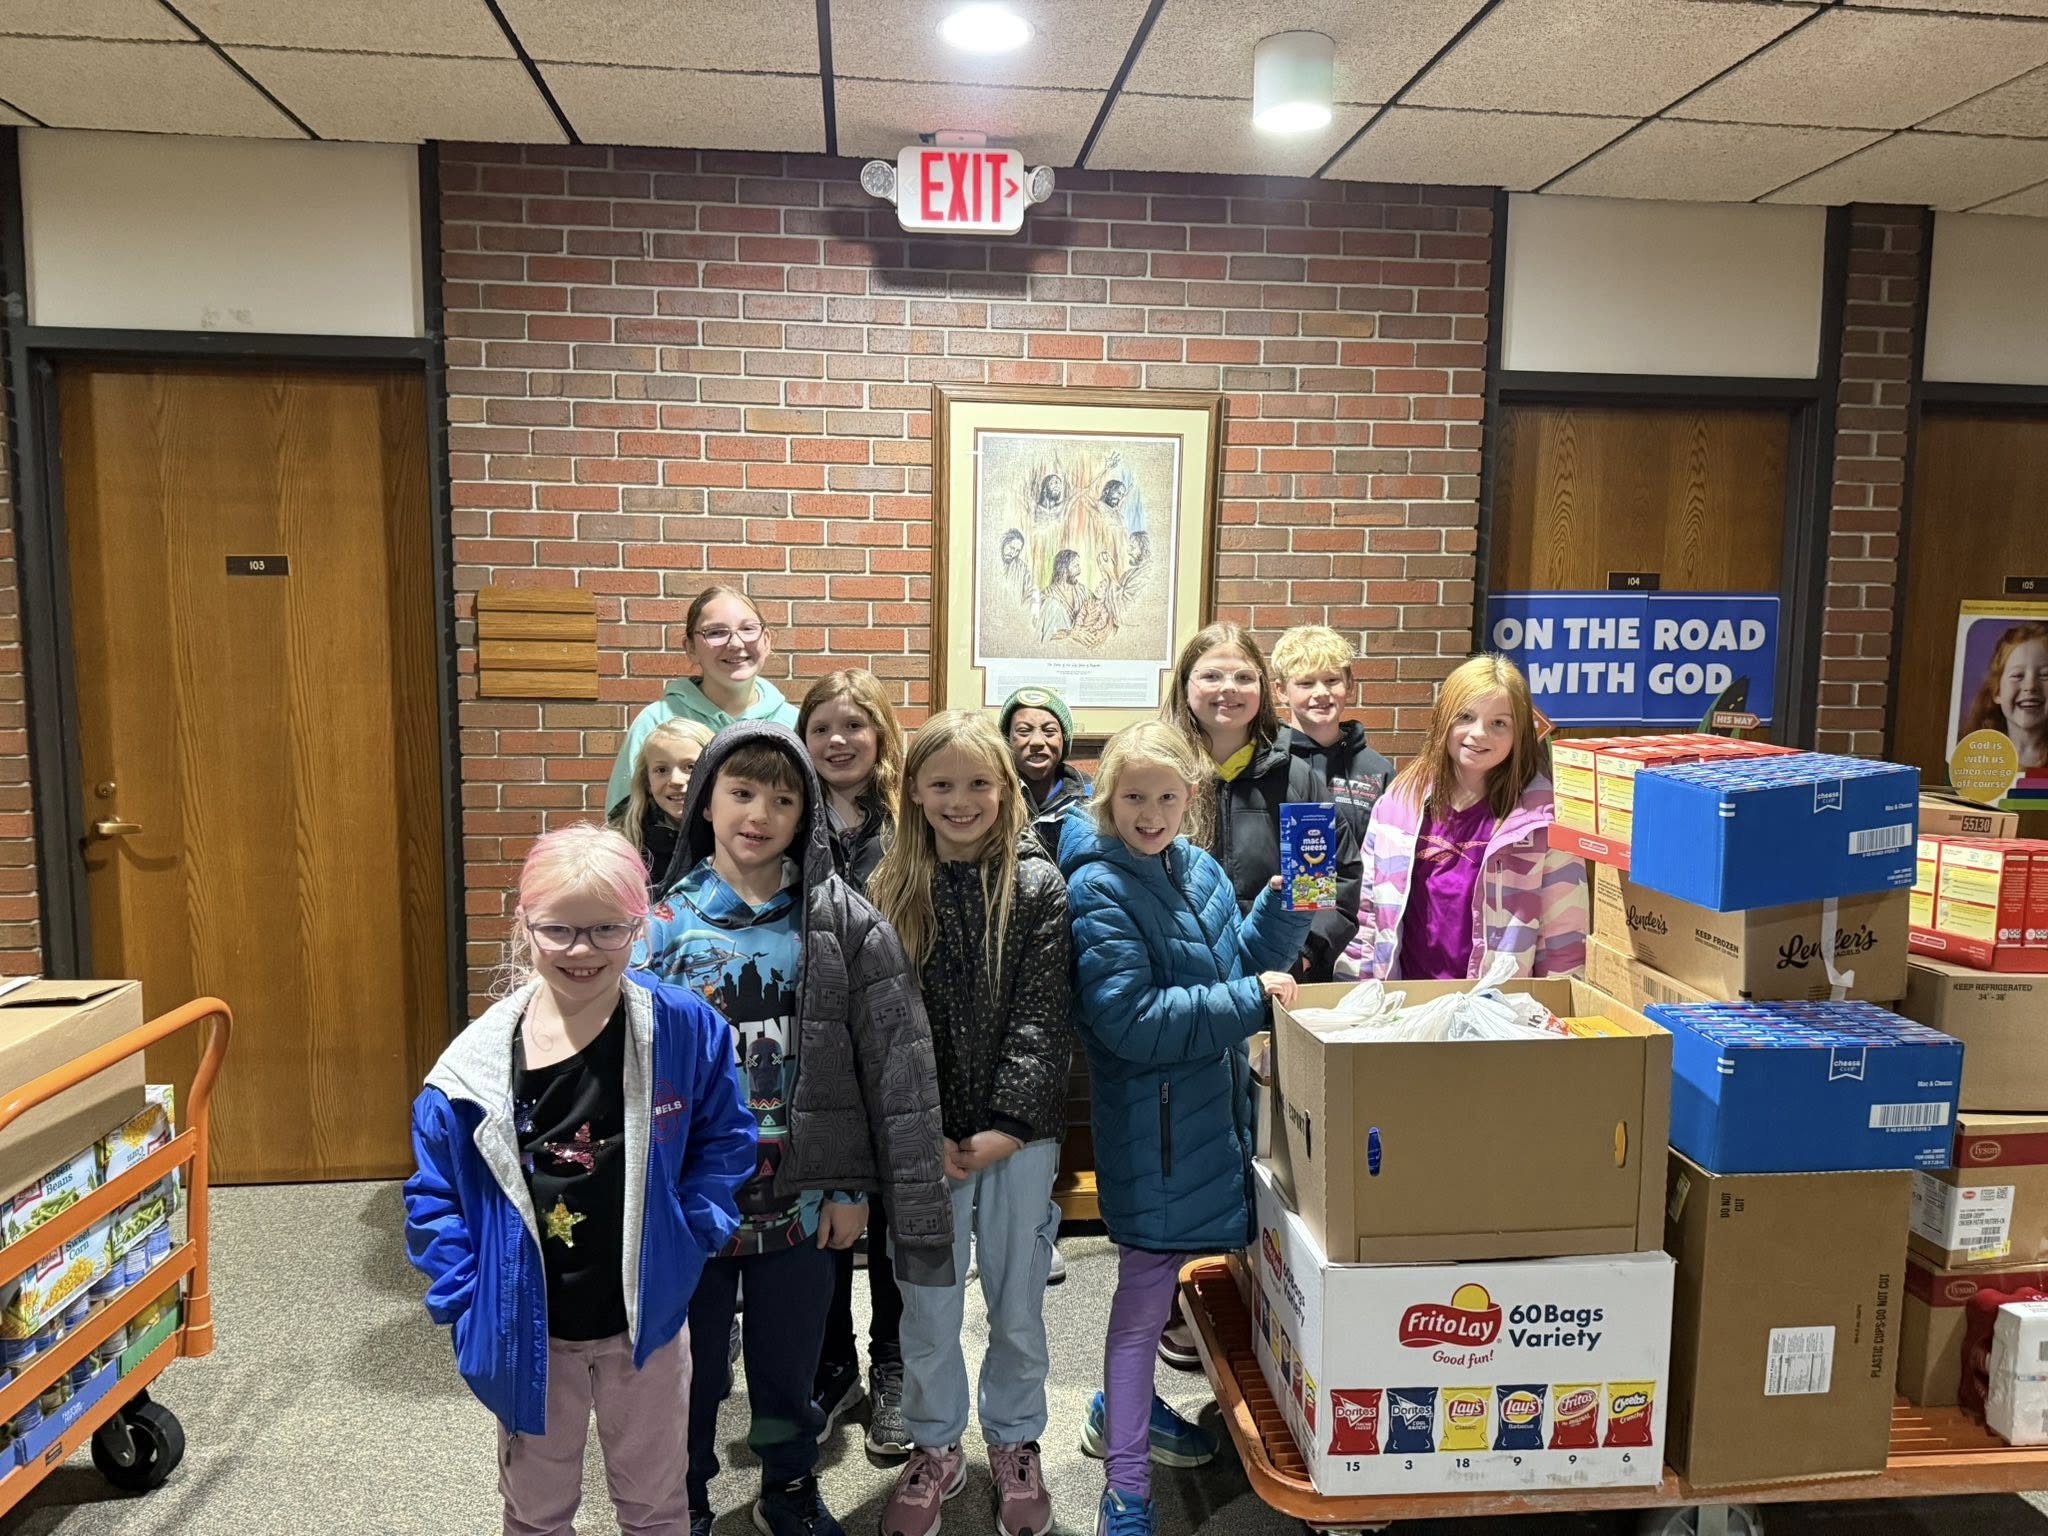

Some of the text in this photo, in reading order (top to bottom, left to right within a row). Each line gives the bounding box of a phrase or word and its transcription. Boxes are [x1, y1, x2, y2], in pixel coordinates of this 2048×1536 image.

[920, 152, 1008, 223] EXIT
[249, 560, 265, 571] 103
[1627, 577, 1641, 586] 104
[2022, 581, 2034, 590] 105
[1492, 617, 1766, 651] ON THE ROAD
[1528, 662, 1733, 695] WITH GOD
[1716, 715, 1753, 725] HIS WAY
[1969, 741, 2002, 750] God is
[1964, 755, 2004, 764] with us
[1954, 767, 1980, 775] when
[1999, 770, 2011, 778] go
[1956, 780, 1970, 788] off
[1962, 817, 1990, 832] 55130
[1626, 905, 1668, 935] Lender's
[1694, 928, 1712, 942] KEEP
[1713, 936, 1739, 954] FROZEN
[1953, 983, 2033, 992] KEEP REFRIGERATED
[46, 1173, 73, 1196] Beans
[1720, 1192, 1731, 1218] DO NOT
[1735, 1198, 1745, 1212] CUT
[69, 1241, 89, 1260] Corn
[1878, 1273, 1890, 1289] CUT
[1876, 1291, 1889, 1307] NOT
[1508, 1304, 1604, 1328] 60 Bags
[1508, 1327, 1602, 1352] Variety
[1432, 1349, 1494, 1369] Good fun!
[1870, 1345, 1884, 1378] PLASTIC
[1506, 1399, 1538, 1416] Lay's
[1561, 1392, 1593, 1412] Fritos
[1335, 1405, 1376, 1418] Doritos
[1391, 1405, 1433, 1417] Doritos
[1450, 1401, 1482, 1418] Lay's
[1619, 1410, 1645, 1424] Crunchy
[1404, 1459, 1413, 1470] 3
[1455, 1458, 1470, 1468] 18
[1513, 1456, 1522, 1466] 9
[1568, 1454, 1577, 1465] 9
[1622, 1452, 1631, 1463] 6
[1345, 1461, 1361, 1472] 15
